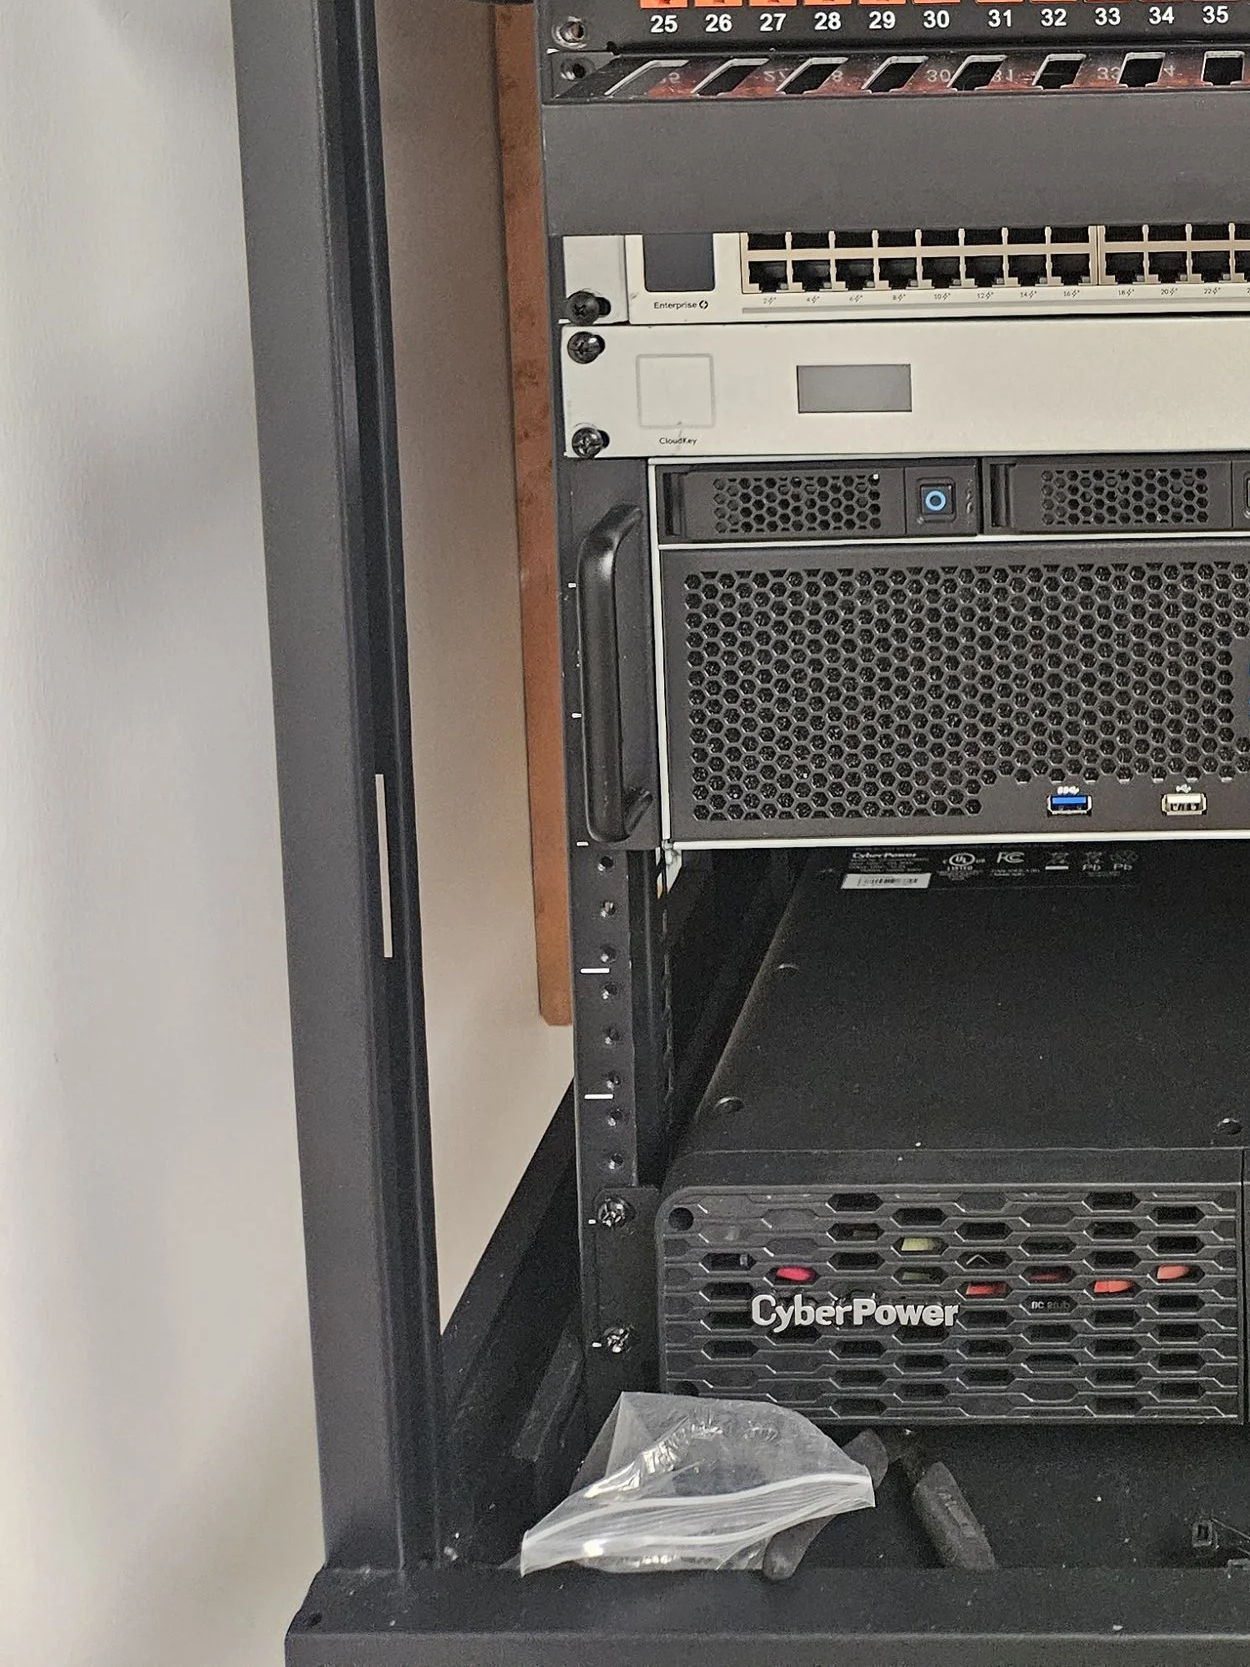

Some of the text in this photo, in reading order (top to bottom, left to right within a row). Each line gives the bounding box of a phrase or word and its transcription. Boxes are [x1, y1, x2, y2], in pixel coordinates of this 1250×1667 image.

[650, 14, 678, 33] 25
[705, 13, 733, 32] 26
[759, 12, 787, 32] 27
[814, 11, 842, 31] 28
[868, 10, 896, 30] 29
[923, 9, 950, 29] 30
[988, 9, 1012, 28] 31
[1041, 8, 1067, 27] 32
[1095, 7, 1121, 26] 33
[1149, 6, 1175, 25] 34
[1202, 5, 1229, 24] 35
[654, 301, 697, 310] Enterprise
[659, 437, 697, 446] CloudKey
[751, 1294, 959, 1333] CyberPower
